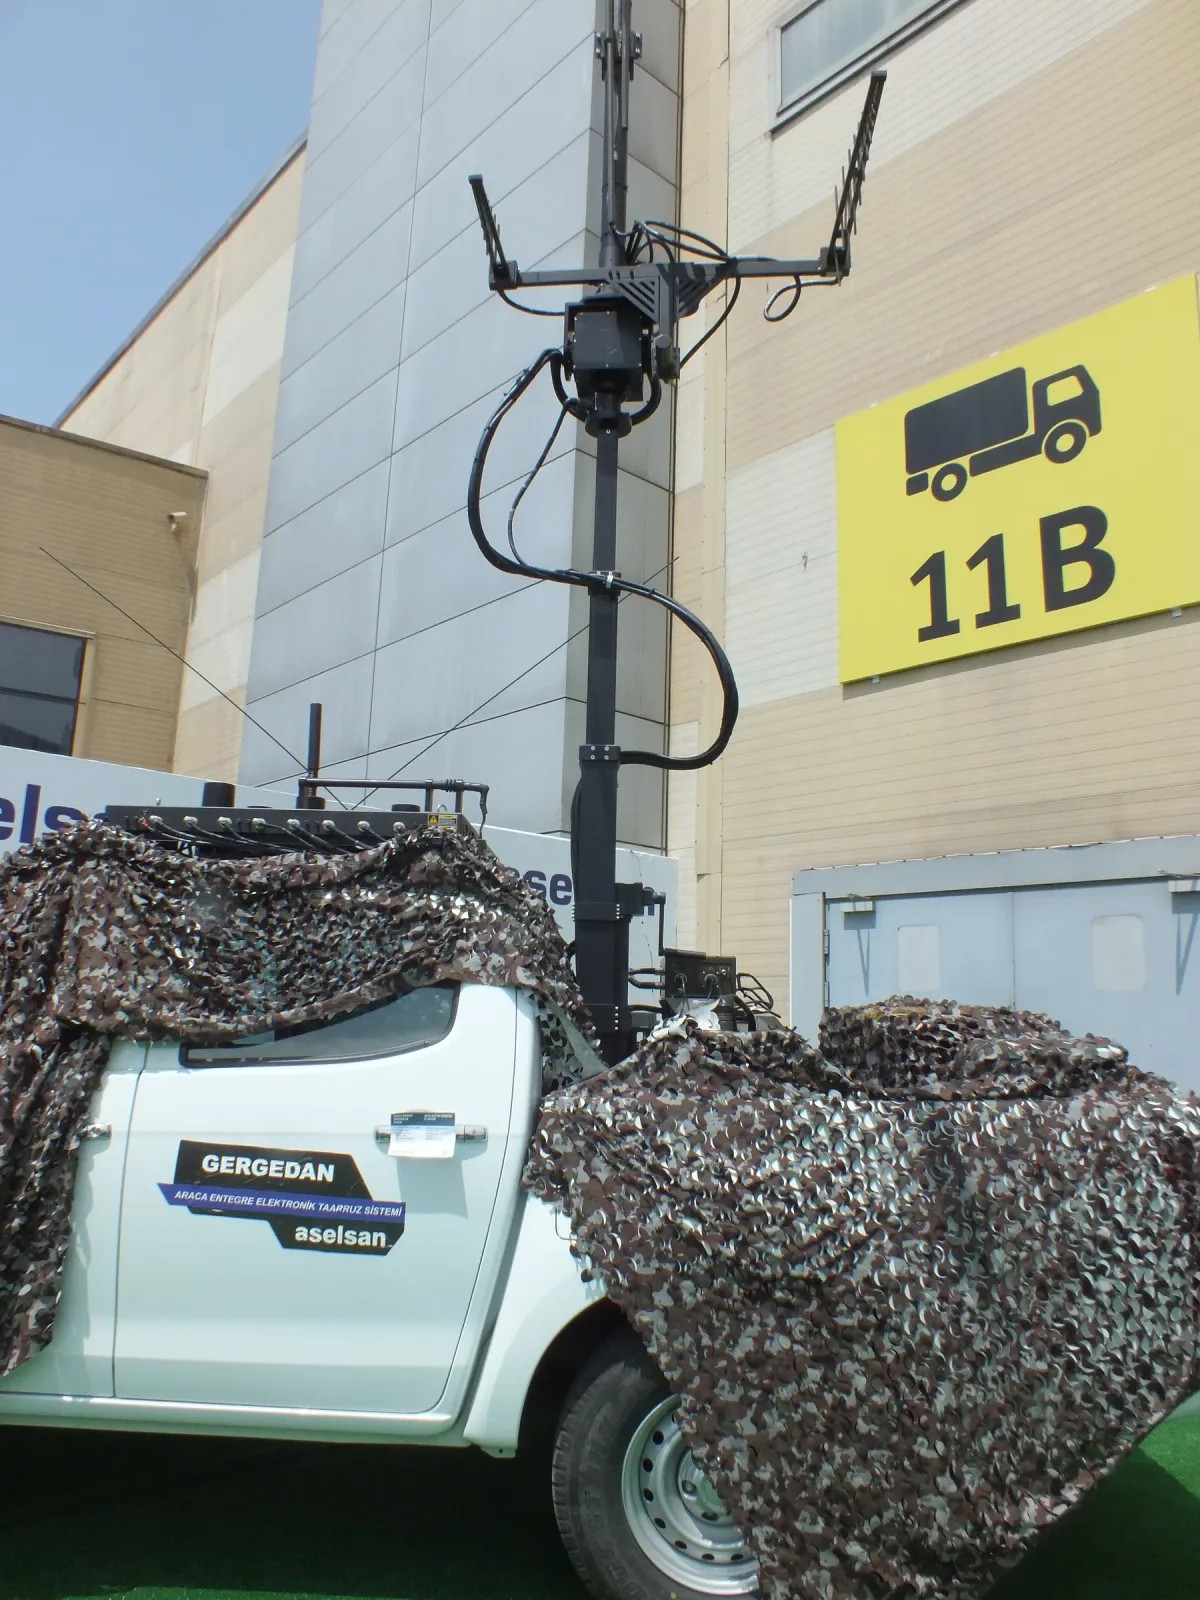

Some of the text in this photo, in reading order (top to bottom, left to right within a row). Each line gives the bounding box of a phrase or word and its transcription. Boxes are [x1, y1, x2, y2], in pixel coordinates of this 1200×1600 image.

[909, 505, 1116, 643] 11B
[202, 1154, 335, 1182] GERGEDAN
[174, 1190, 403, 1217] ARACA ENTEGRE ELEKTRONİK TAARRUZ SİSTEMİ
[294, 1225, 387, 1248] aselsan
